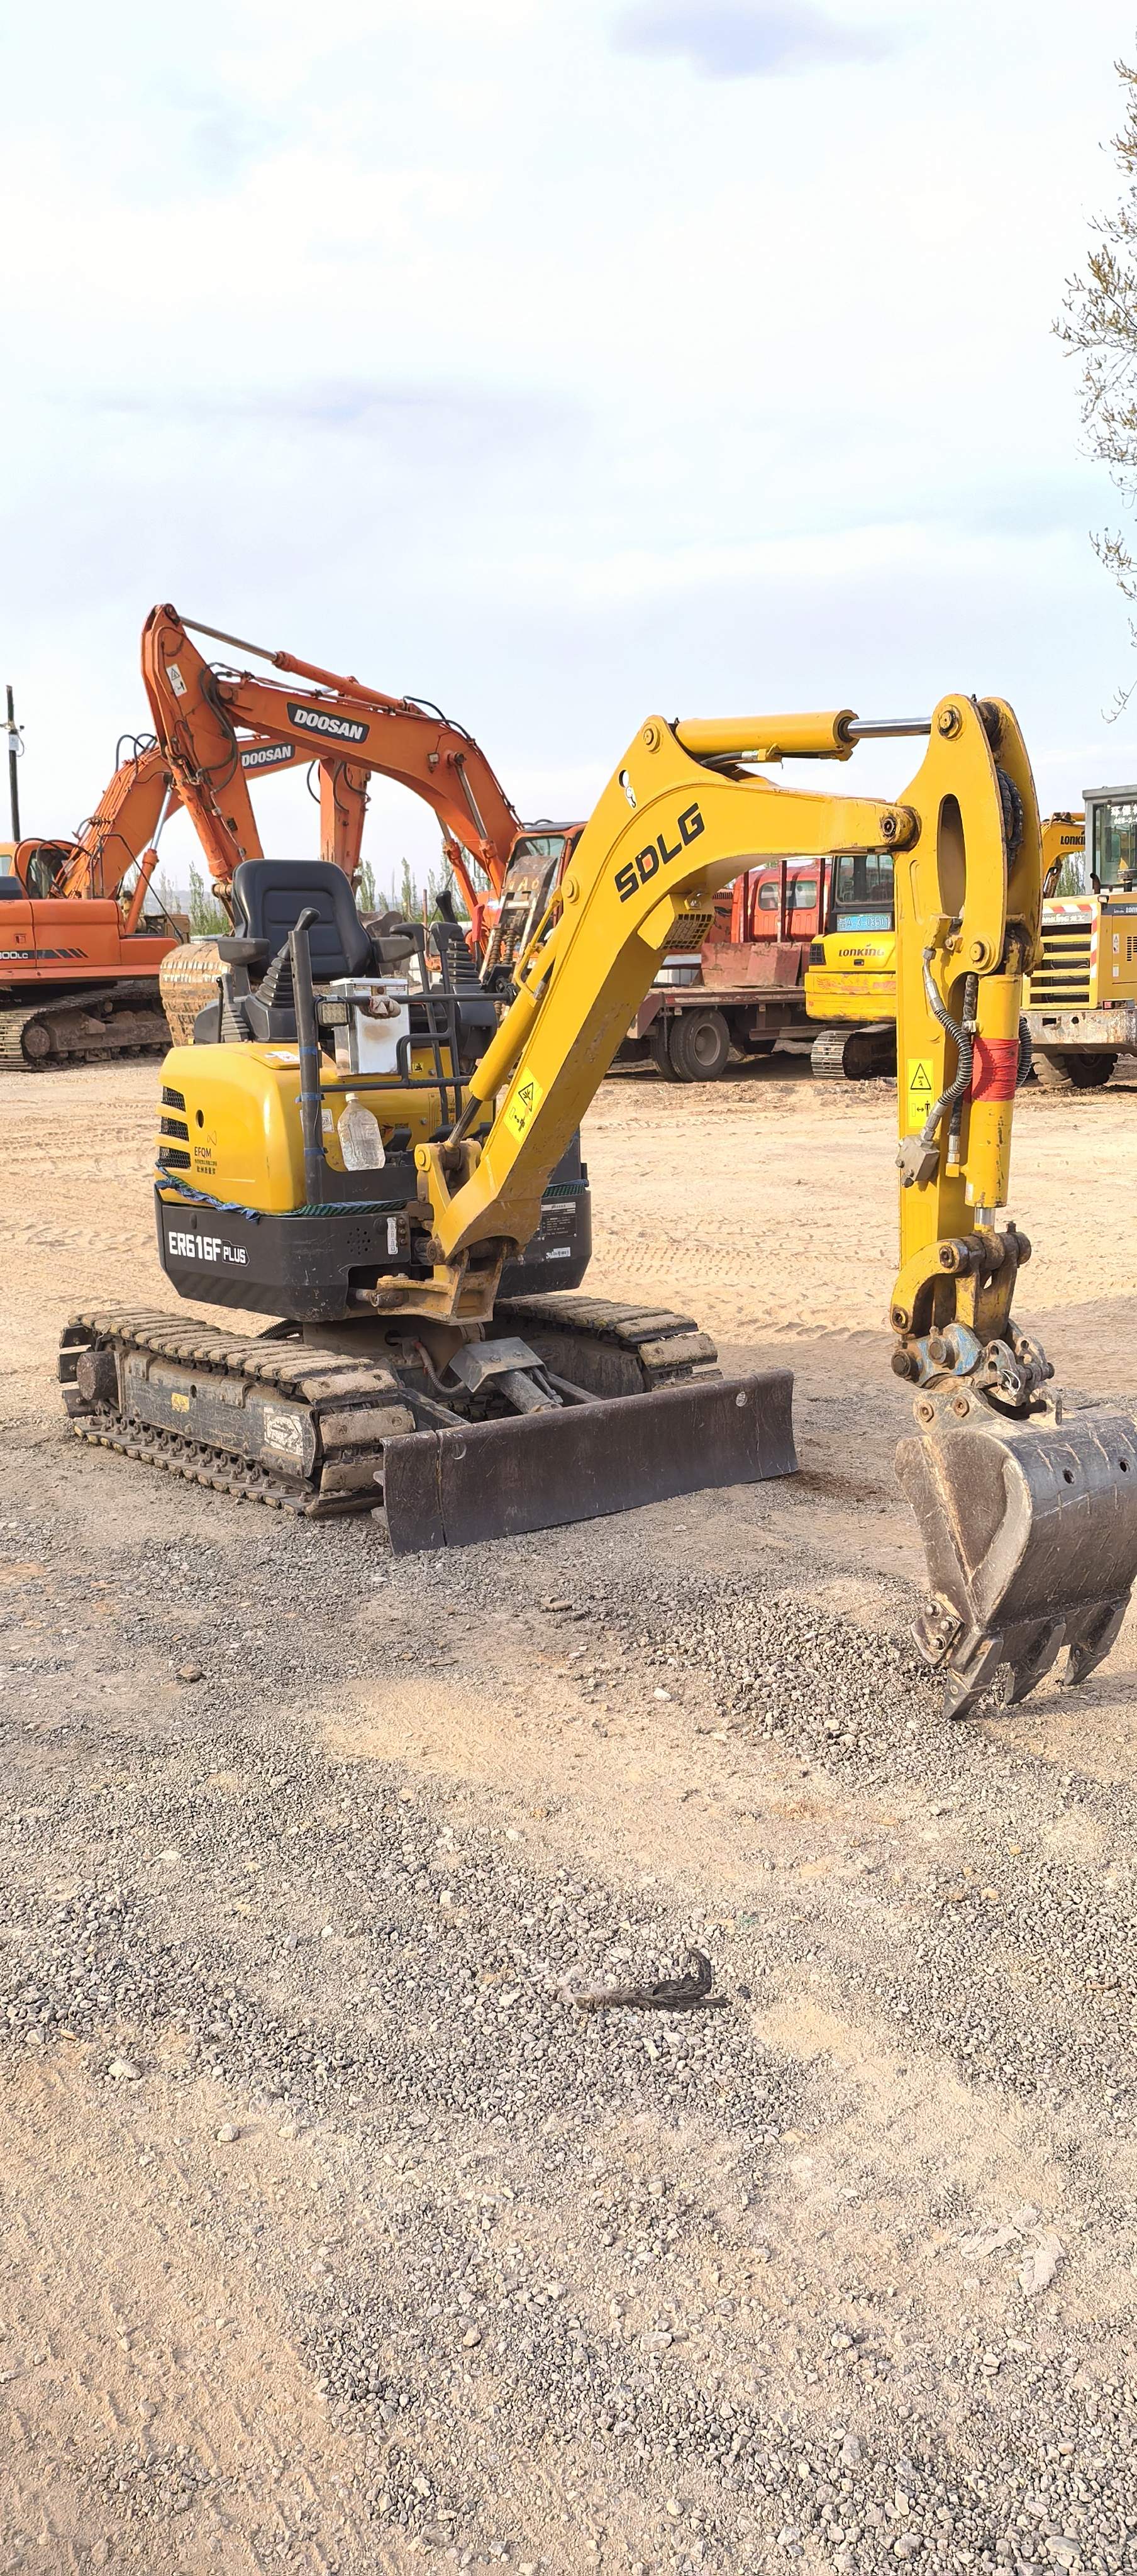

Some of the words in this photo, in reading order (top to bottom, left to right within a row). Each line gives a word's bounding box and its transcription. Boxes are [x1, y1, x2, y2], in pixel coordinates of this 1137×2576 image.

[294, 709, 363, 740] DOOSAN
[241, 745, 291, 767] DOOSAN
[614, 802, 705, 902] SDLG
[0, 951, 28, 960] 00LC
[838, 944, 884, 957] LONKING
[194, 1146, 211, 1158] EFQM
[169, 1231, 221, 1261] ER616F
[223, 1246, 246, 1263] PLUS
